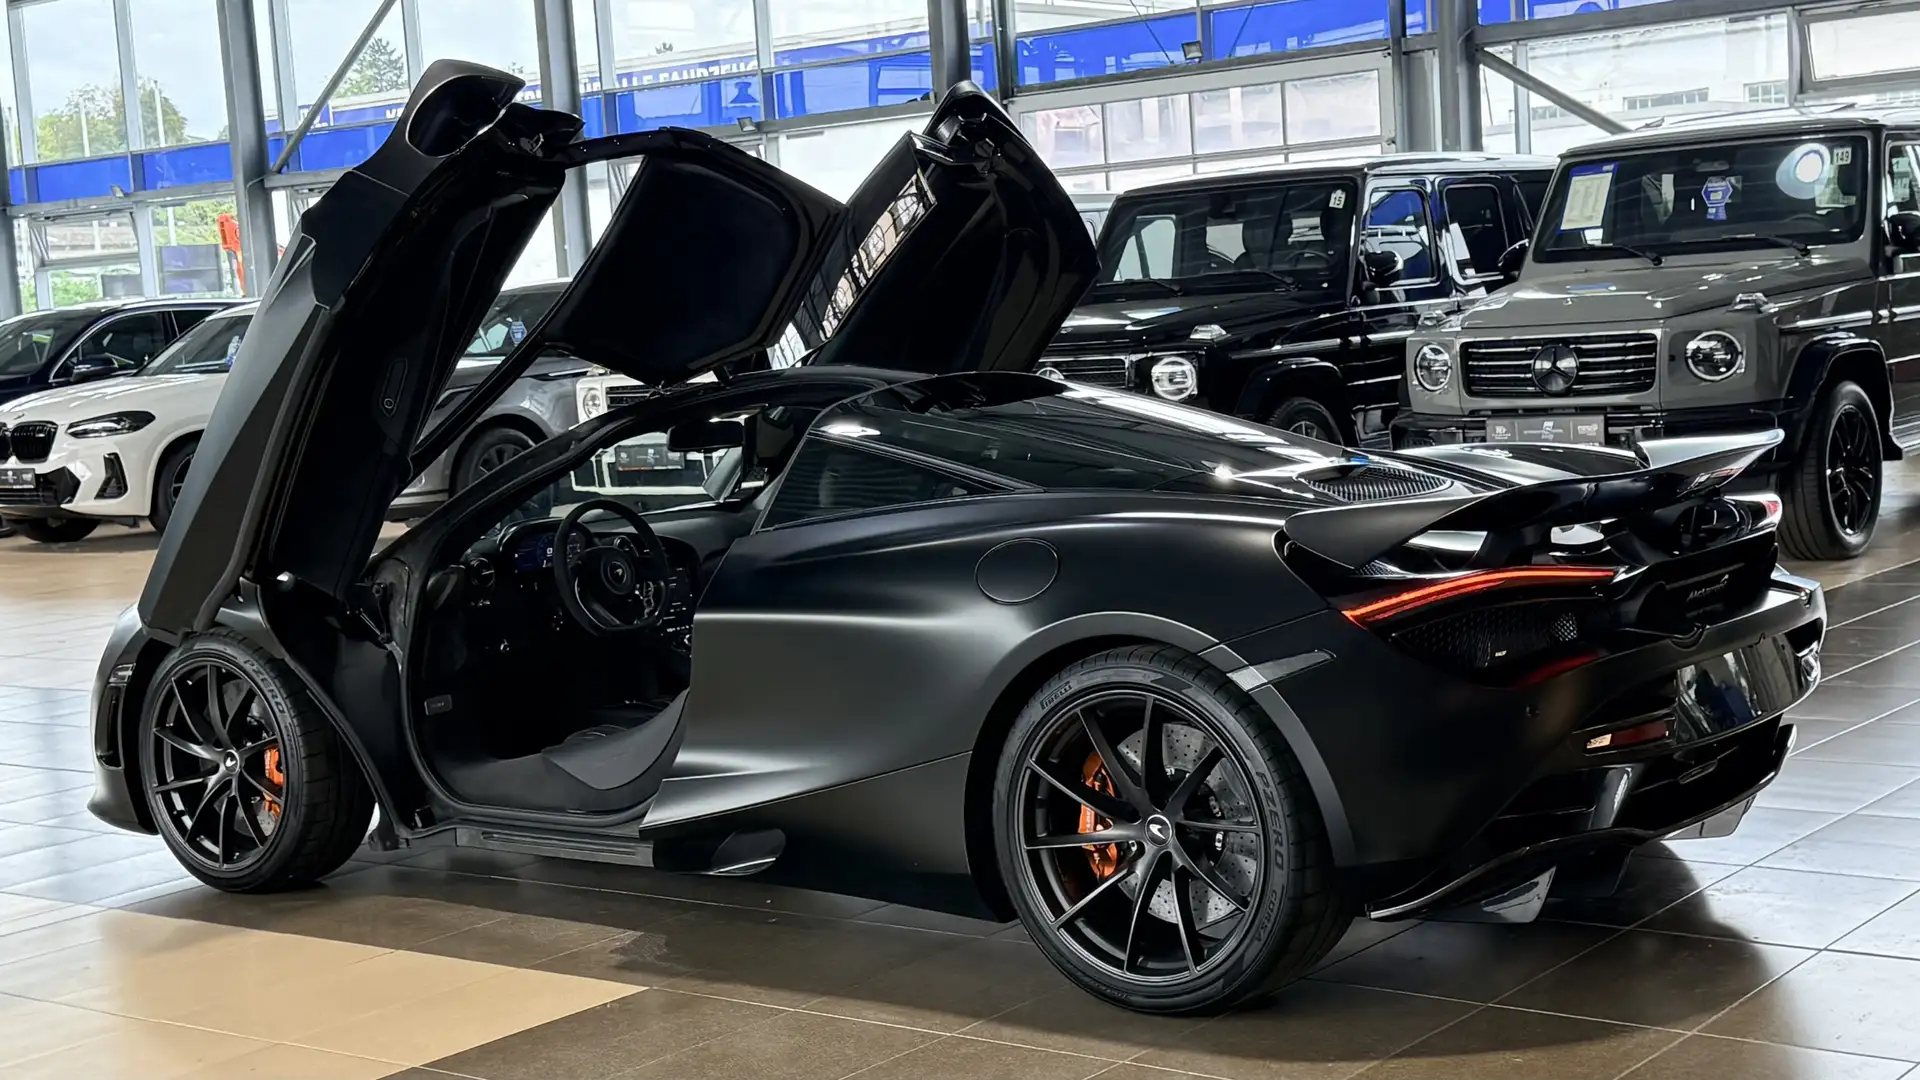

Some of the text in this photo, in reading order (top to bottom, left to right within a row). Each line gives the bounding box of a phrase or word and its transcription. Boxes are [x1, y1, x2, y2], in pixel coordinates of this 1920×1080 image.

[1835, 150, 1850, 163] 149
[1333, 196, 1343, 206] 15
[1039, 680, 1073, 710] PIRELLI
[1255, 889, 1278, 942] CORSA
